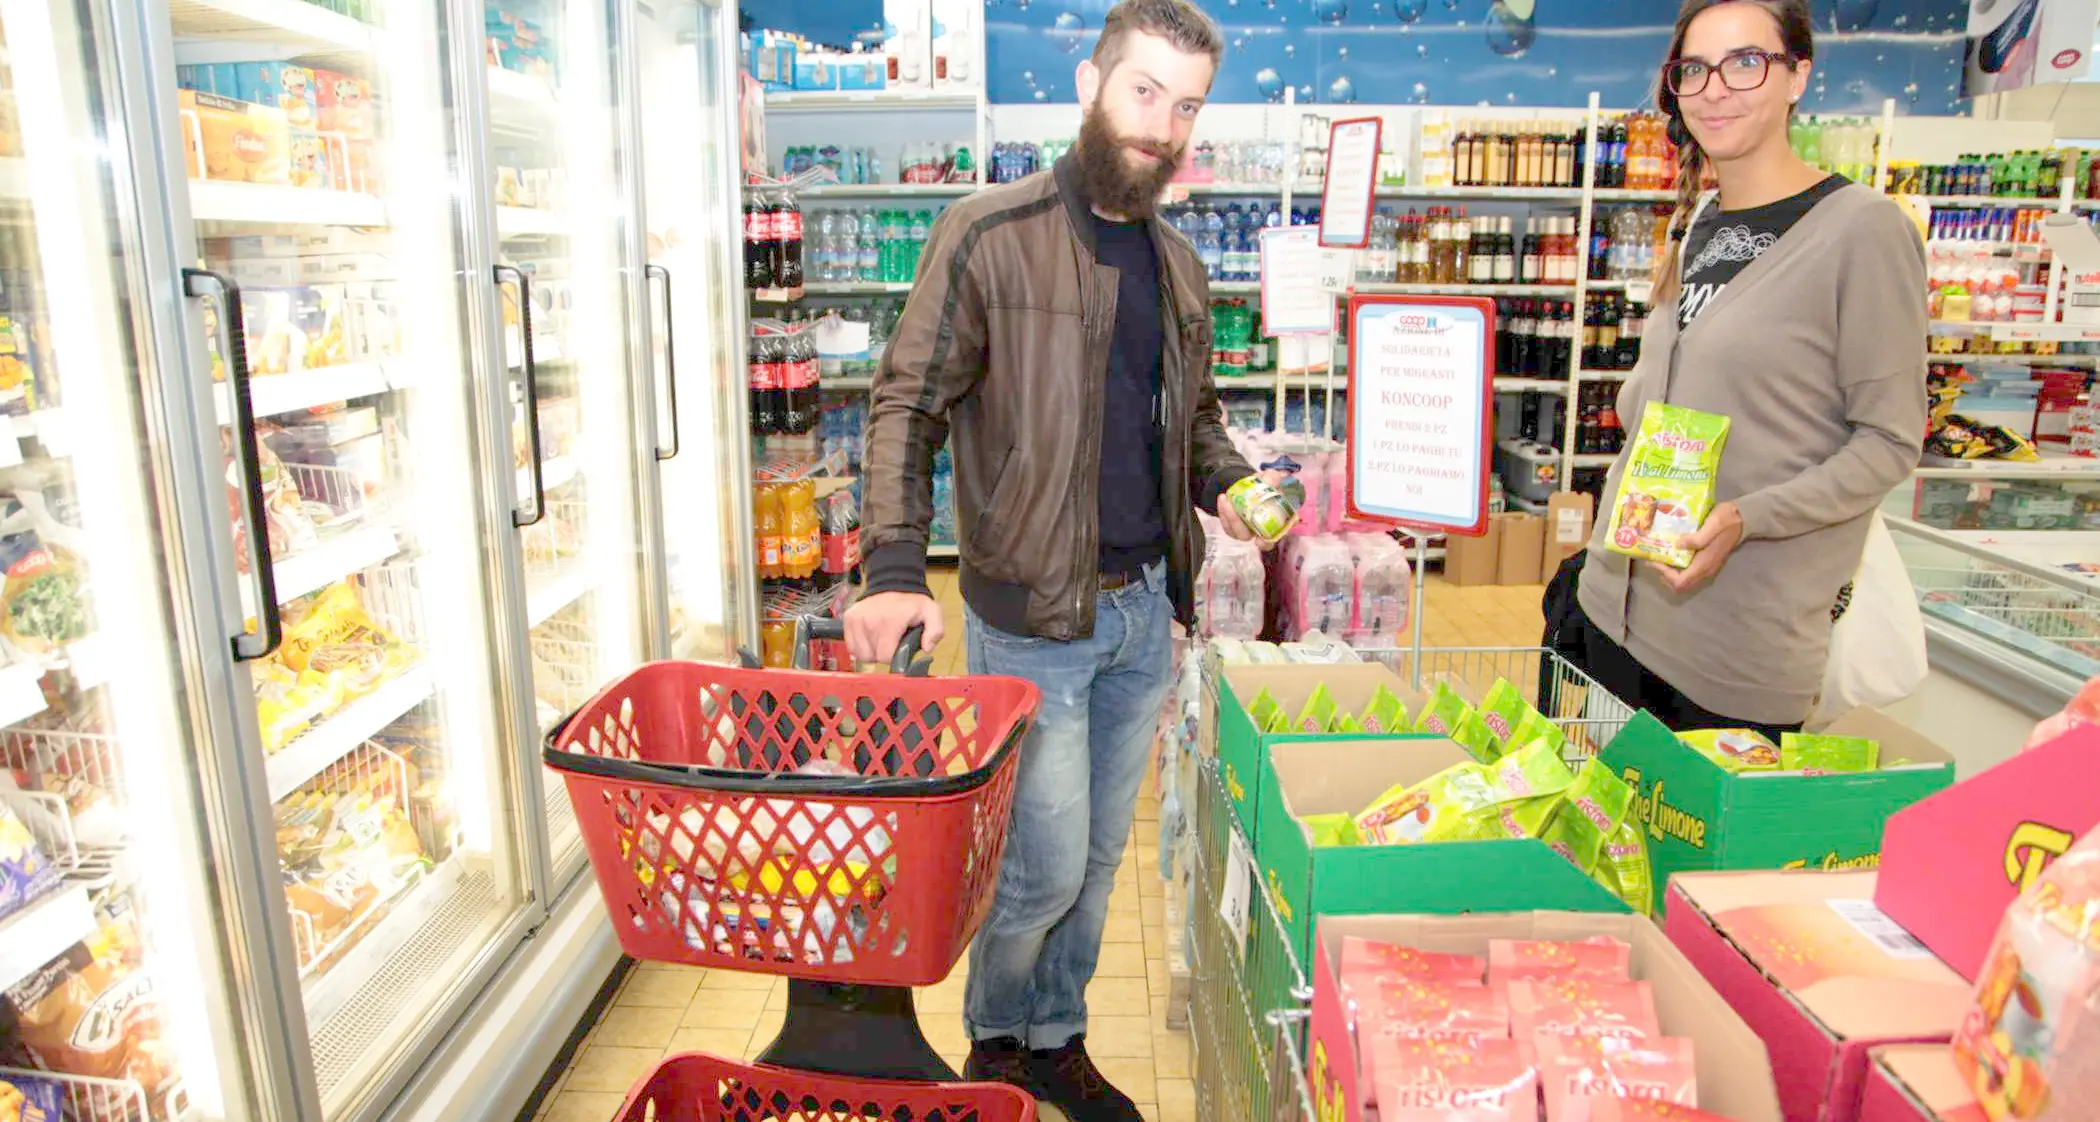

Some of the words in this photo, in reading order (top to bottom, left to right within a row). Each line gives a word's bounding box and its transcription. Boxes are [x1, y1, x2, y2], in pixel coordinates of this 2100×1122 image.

[1380, 365, 1400, 377] PER
[1381, 390, 1453, 409] KONCOOP
[1385, 419, 1421, 432] PRENDI
[1433, 423, 1448, 434] PZ
[1396, 442, 1410, 453] LO
[1412, 444, 1445, 456] PAGHI
[1448, 447, 1463, 459] TU
[1392, 462, 1406, 474] LO
[1407, 465, 1465, 480] PAGHIAMO
[1405, 484, 1423, 495] NOI
[1649, 779, 1705, 849] Limone
